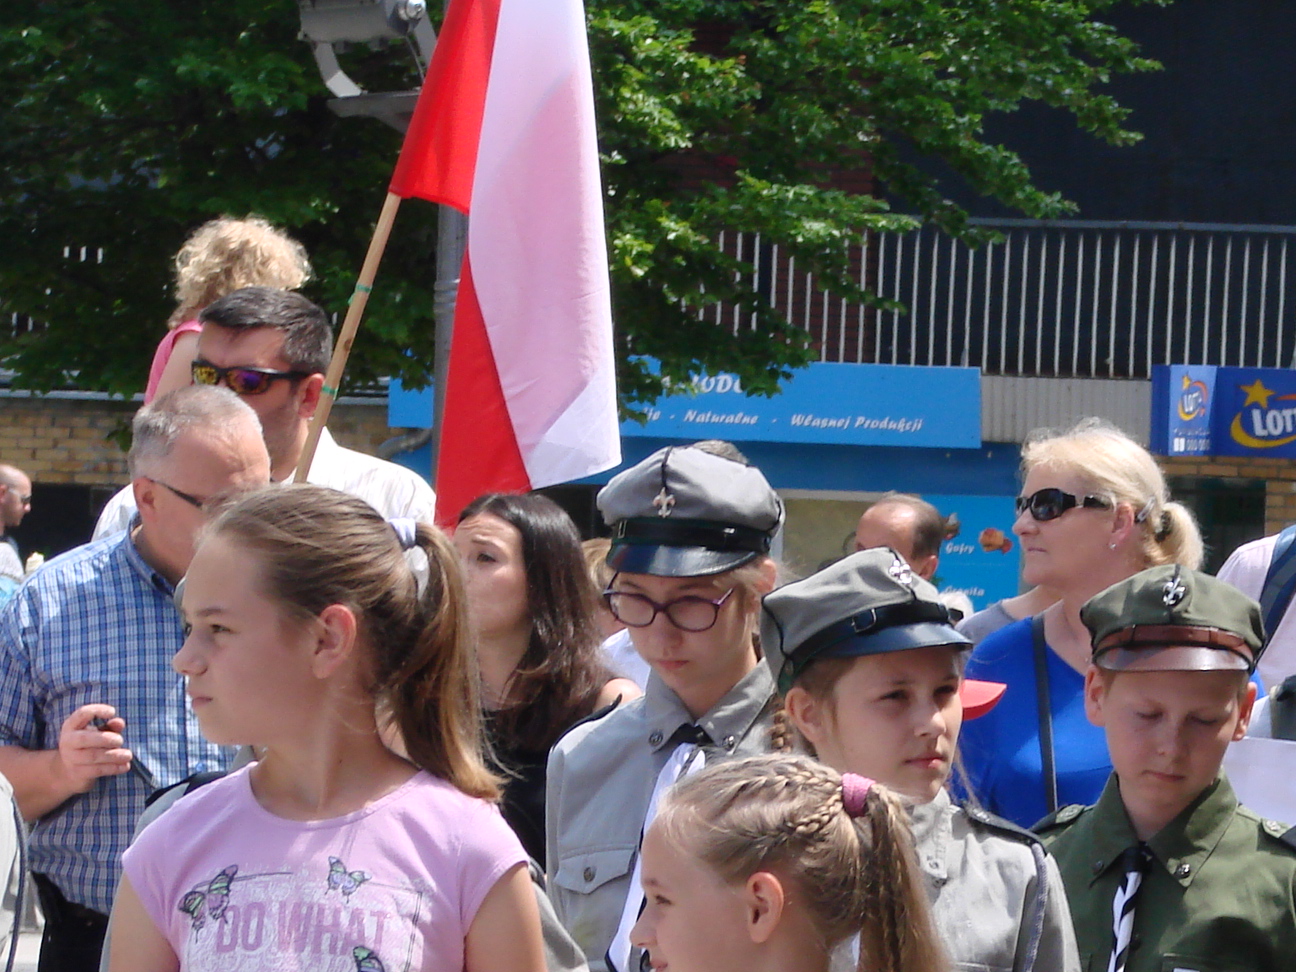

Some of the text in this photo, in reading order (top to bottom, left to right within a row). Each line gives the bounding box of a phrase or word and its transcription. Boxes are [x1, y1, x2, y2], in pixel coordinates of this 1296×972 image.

[683, 409, 758, 425] Naturalne
[791, 413, 850, 431] Własnej
[854, 415, 924, 432] Produkcji
[215, 900, 389, 956] DO WHAT
